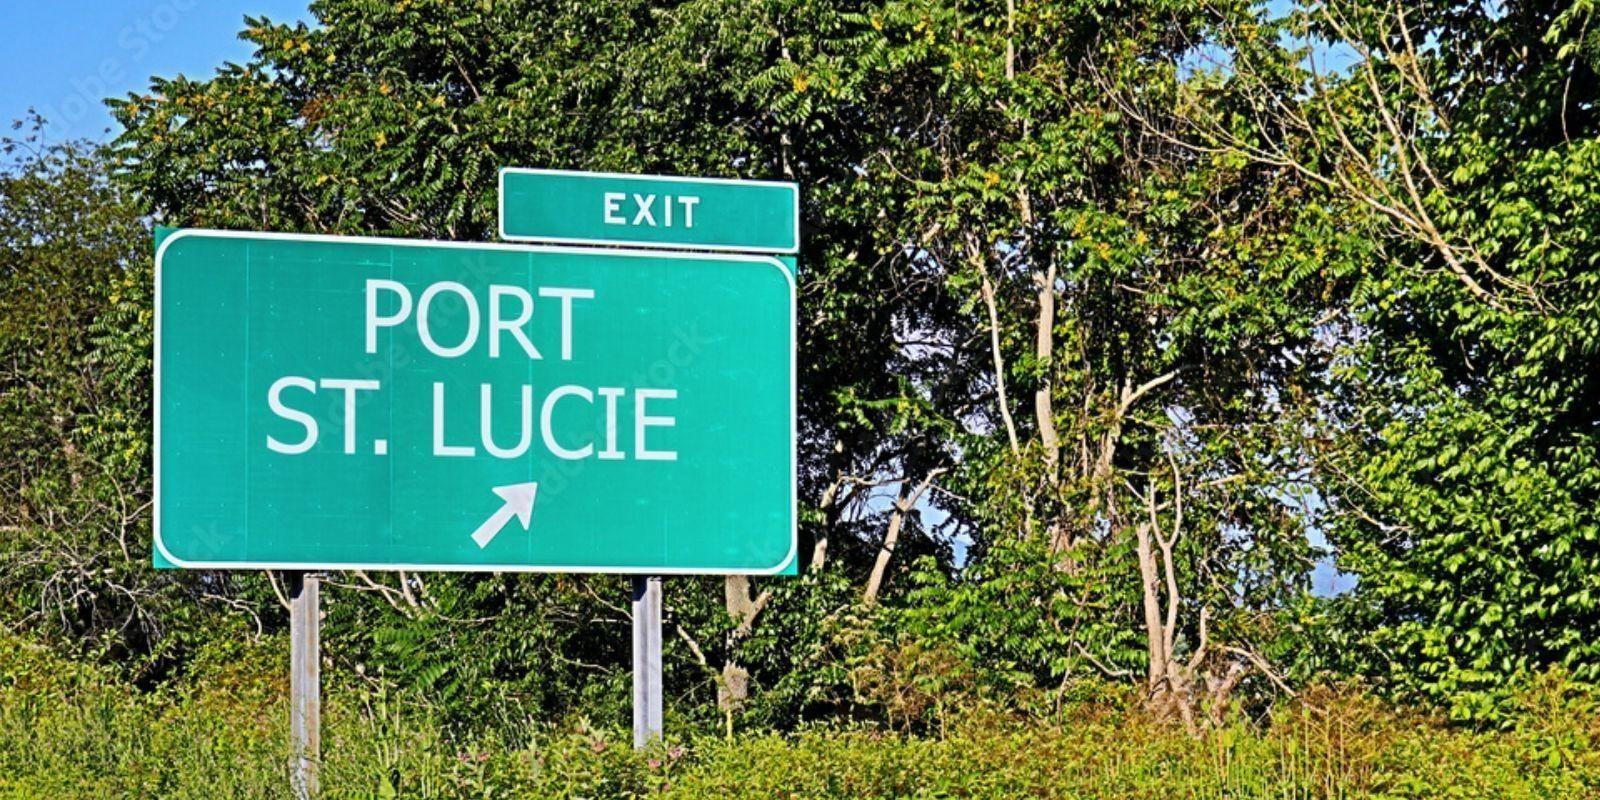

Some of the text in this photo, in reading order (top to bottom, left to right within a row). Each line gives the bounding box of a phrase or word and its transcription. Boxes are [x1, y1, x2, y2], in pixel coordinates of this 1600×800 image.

[604, 192, 701, 228] EXIT
[365, 279, 595, 360] PORT
[266, 376, 678, 461] ST. LUCIE
